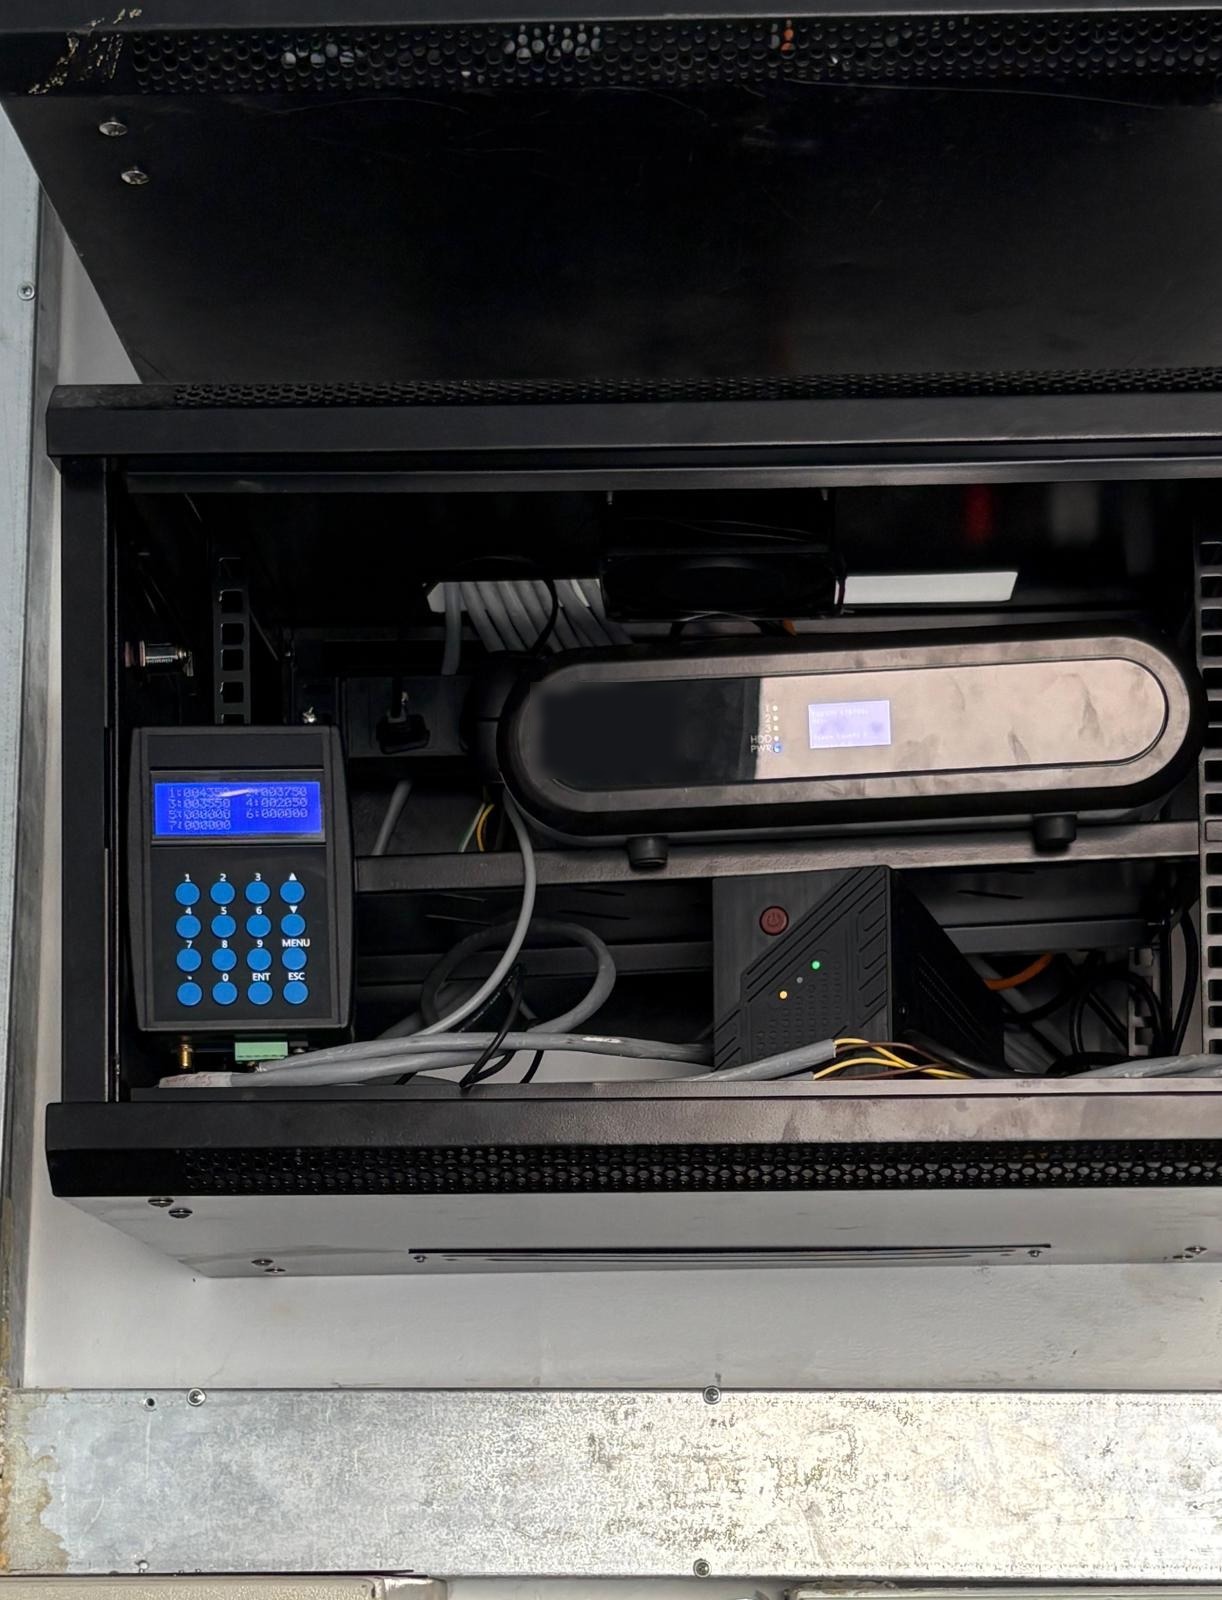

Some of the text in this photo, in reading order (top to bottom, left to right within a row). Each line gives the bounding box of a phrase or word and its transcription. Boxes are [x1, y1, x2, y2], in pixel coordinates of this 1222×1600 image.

[750, 734, 773, 744] HDD
[750, 744, 773, 753] PWR
[185, 873, 191, 882] 1
[220, 873, 226, 882] 2
[255, 873, 261, 881] 3
[185, 907, 192, 915] 4
[221, 906, 227, 915] 5
[256, 906, 262, 914] 6
[186, 940, 193, 948] 7
[221, 940, 228, 948] 8
[257, 939, 263, 948] 9
[282, 939, 310, 948] MENU
[222, 974, 229, 982] 0
[252, 973, 271, 981] ENT
[288, 972, 305, 981] ESC
